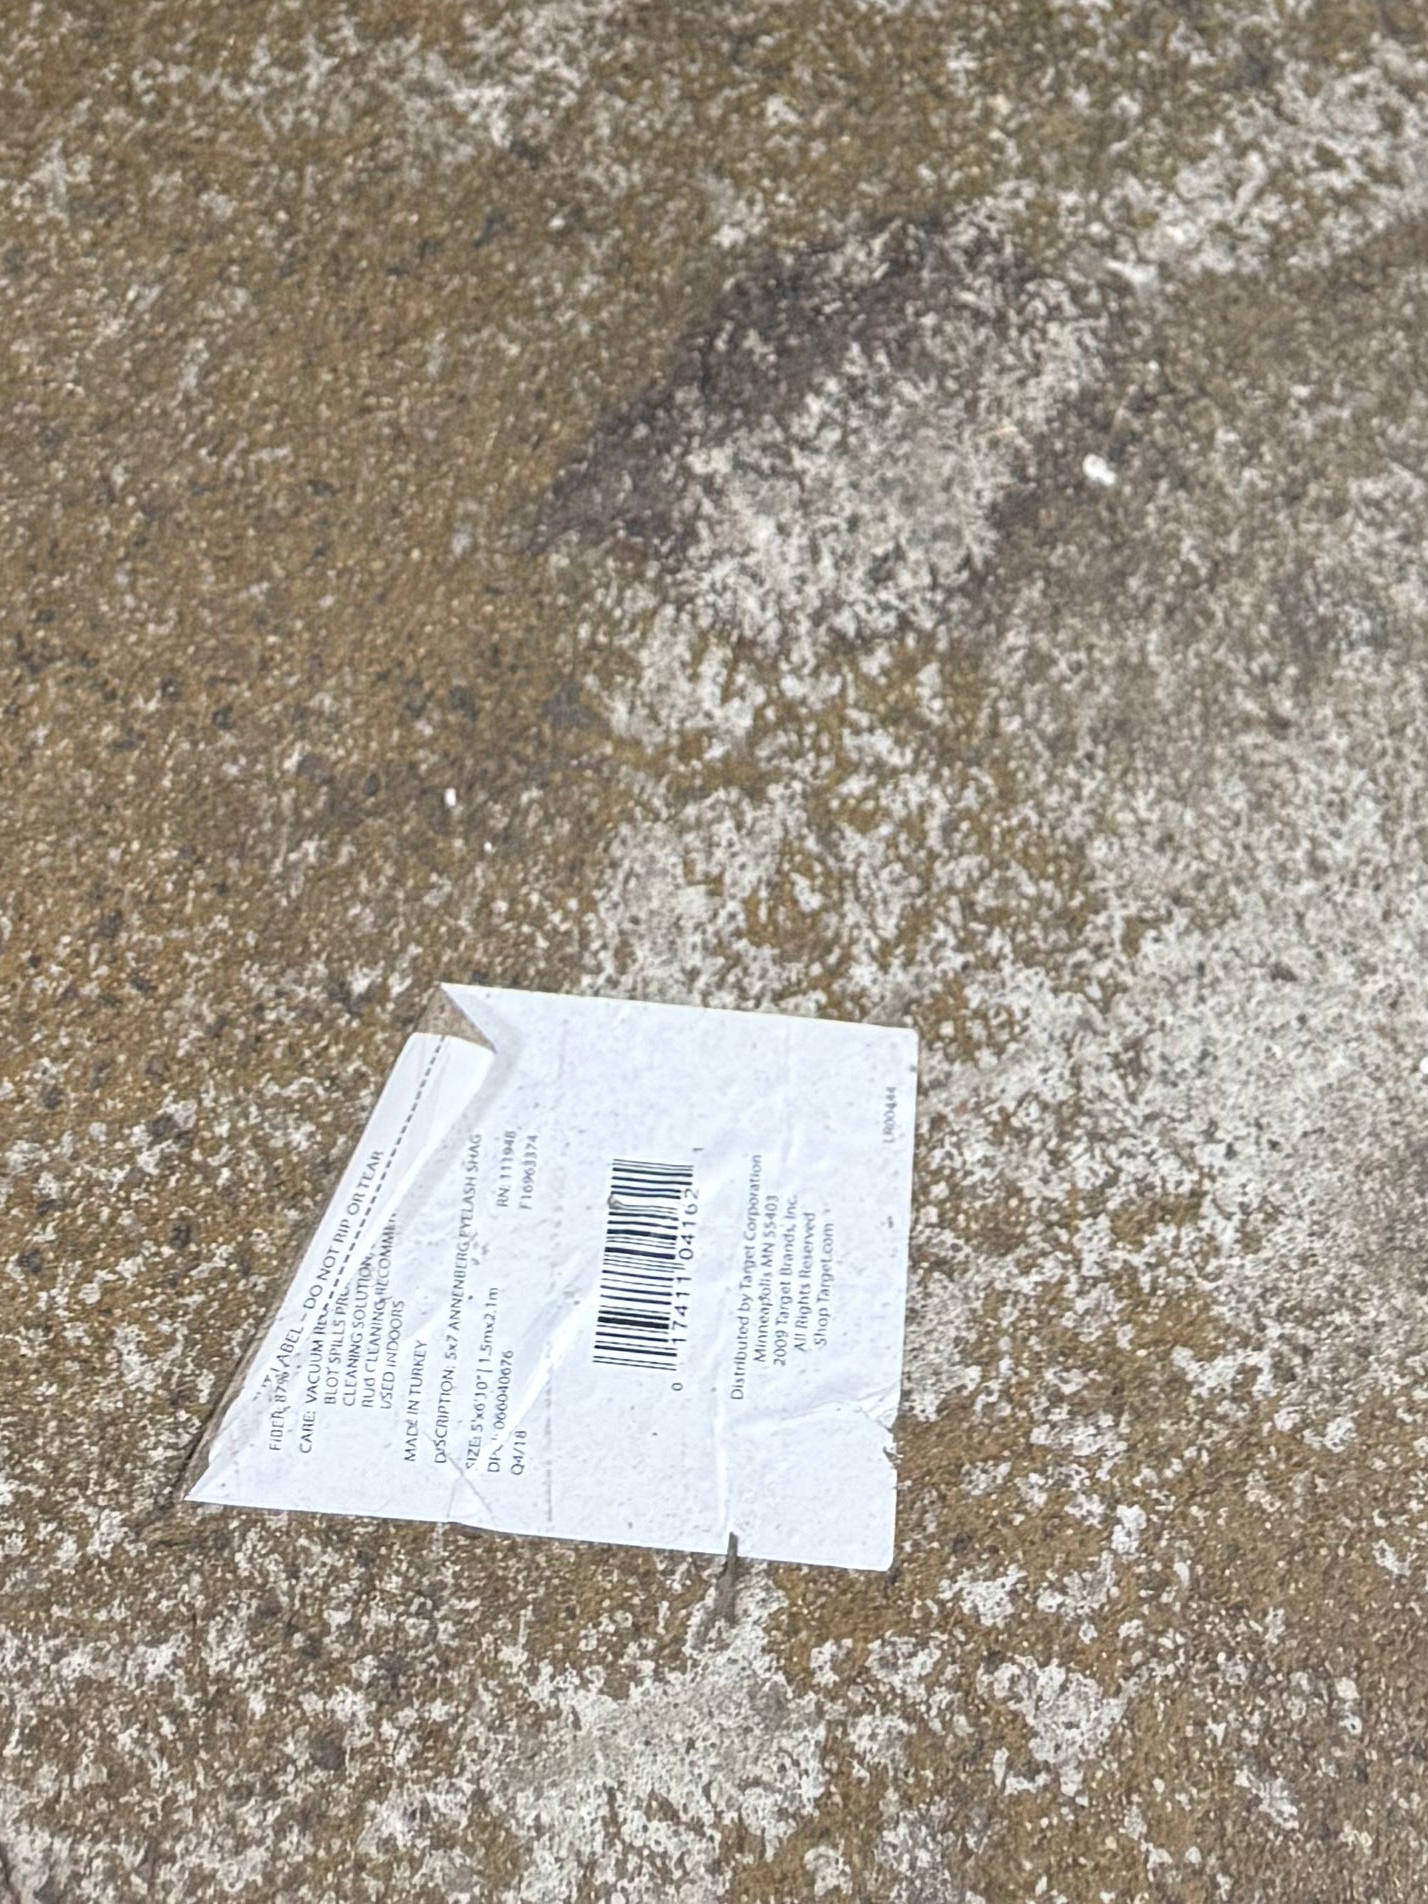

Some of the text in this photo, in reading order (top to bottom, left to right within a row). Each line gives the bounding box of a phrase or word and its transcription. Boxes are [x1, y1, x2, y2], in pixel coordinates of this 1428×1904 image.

[466, 1134, 481, 1172] SHAG
[303, 1284, 324, 1309] DO
[316, 1246, 343, 1280] NOT
[333, 1220, 352, 1242] RIP
[346, 1194, 366, 1215] OR
[358, 1151, 384, 1190] TEAR
[458, 1176, 477, 1238] EYELASH
[496, 1184, 510, 1207] RN:
[679, 1187, 698, 1260] 04162
[449, 1242, 469, 1331] ANNENBERG
[672, 1275, 691, 1345] 17411
[731, 1155, 763, 1400] Distributed by Target Corporation
[754, 1195, 778, 1363] Minneapolis MN 55403
[774, 1195, 797, 1366] 2009 Target Brands, Inc.
[795, 1212, 815, 1352] All Rights Reserved
[815, 1223, 835, 1346] Shop Target.com
[328, 1319, 345, 1363] SPILLS
[343, 1333, 364, 1406] CLEANING
[365, 1298, 385, 1373] CLEANING
[381, 1300, 404, 1409] USED INDOORS
[444, 1334, 458, 1360] 5x7
[305, 1340, 324, 1403] VACUUM
[324, 1365, 338, 1405] BLOT
[363, 1378, 377, 1408] RUG
[405, 1340, 427, 1462] MADE IN TURKEY
[671, 1383, 683, 1391] 0
[299, 1411, 316, 1454] CARE:
[466, 1437, 481, 1469] SIZE:
[511, 1430, 527, 1475] Q4/18
